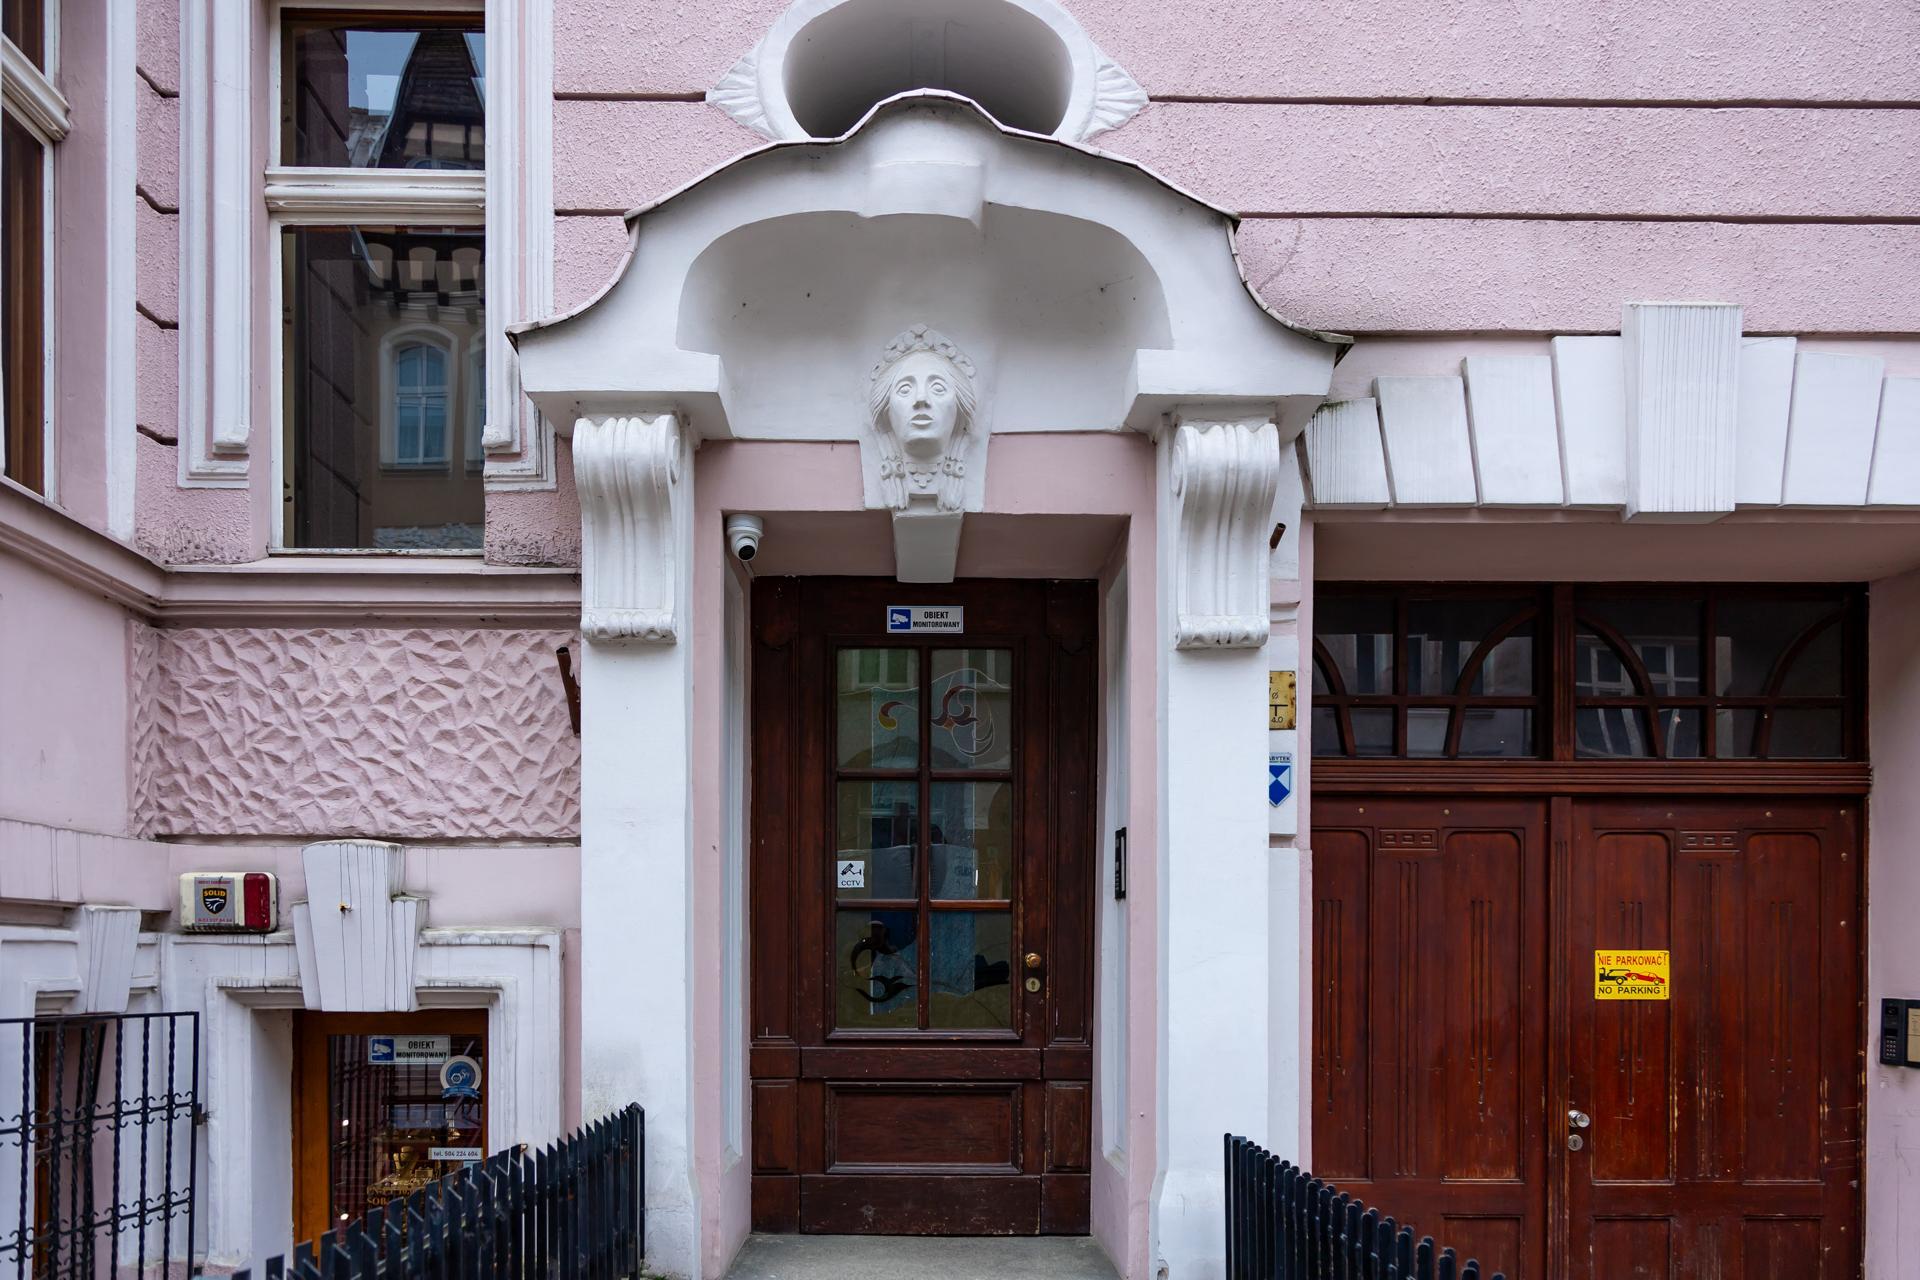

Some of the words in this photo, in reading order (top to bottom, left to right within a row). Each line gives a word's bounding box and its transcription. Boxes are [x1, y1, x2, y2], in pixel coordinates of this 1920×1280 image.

[923, 611, 949, 619] OBIEKT
[1598, 956, 1612, 965] NIE
[408, 1041, 435, 1049] OBIEKT
